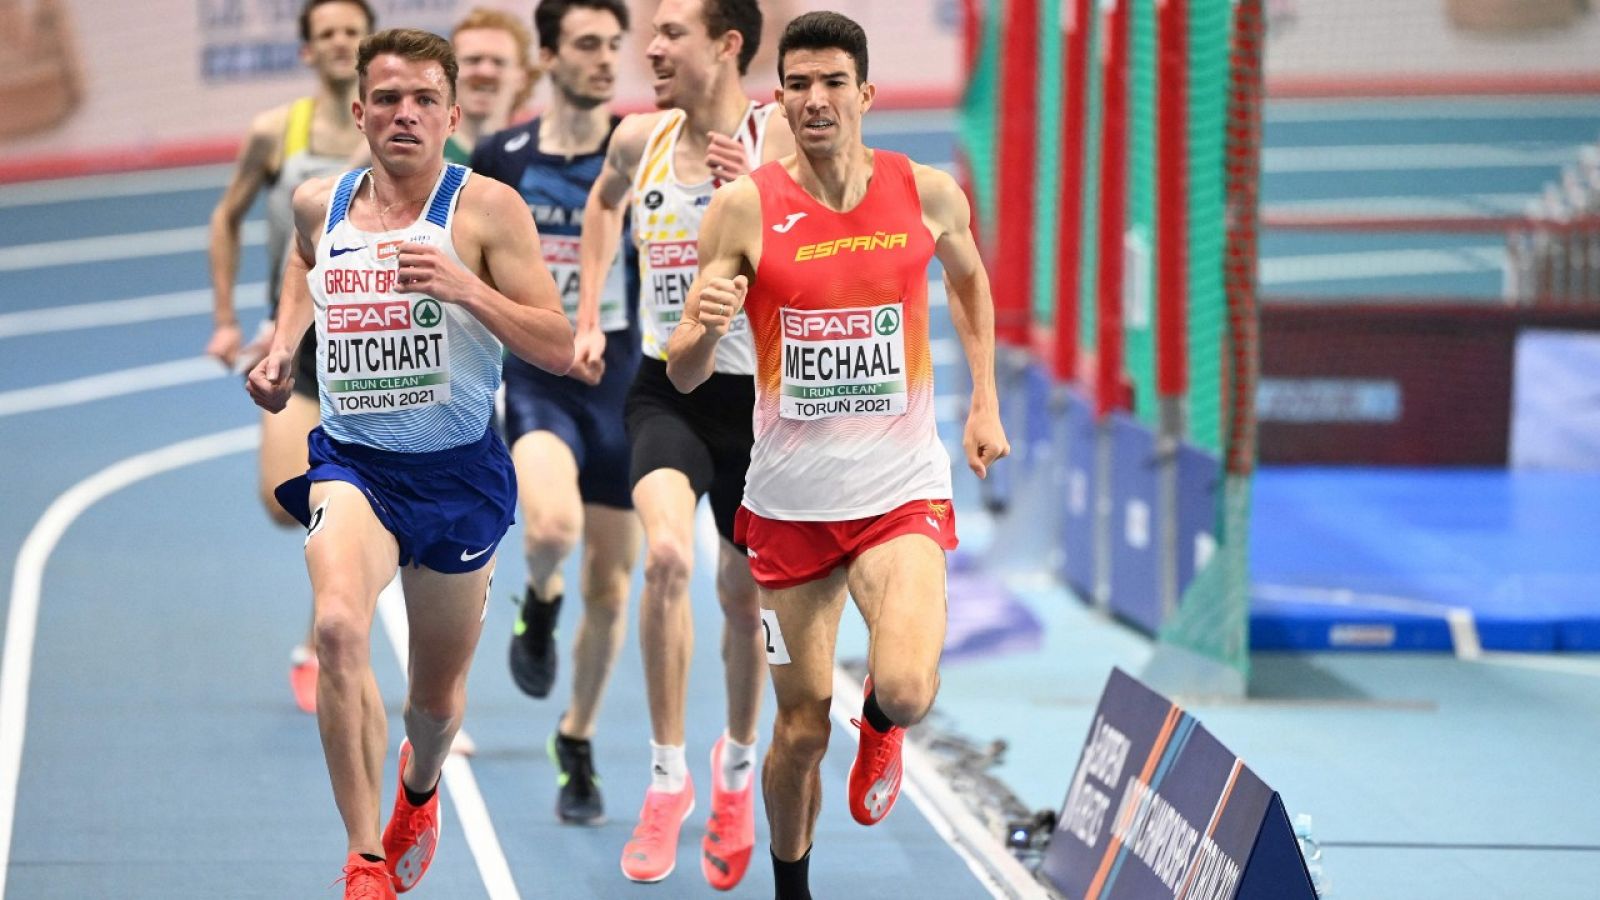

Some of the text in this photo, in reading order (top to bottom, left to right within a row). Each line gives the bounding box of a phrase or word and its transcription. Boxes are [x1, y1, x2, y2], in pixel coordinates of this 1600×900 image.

[649, 243, 697, 266] SPA
[795, 231, 908, 262] ESPAÑA
[325, 269, 400, 294] GREAT BR
[652, 273, 693, 305] HEN
[328, 305, 409, 330] SPAR
[785, 314, 870, 337] SPAR
[327, 333, 442, 374] BUTCHART
[785, 342, 900, 381] MECHAAL
[351, 379, 377, 390] RUN
[809, 387, 835, 398] RUN
[338, 389, 435, 411] TORUŃ 2021
[795, 398, 891, 416] TORUŃ 2021
